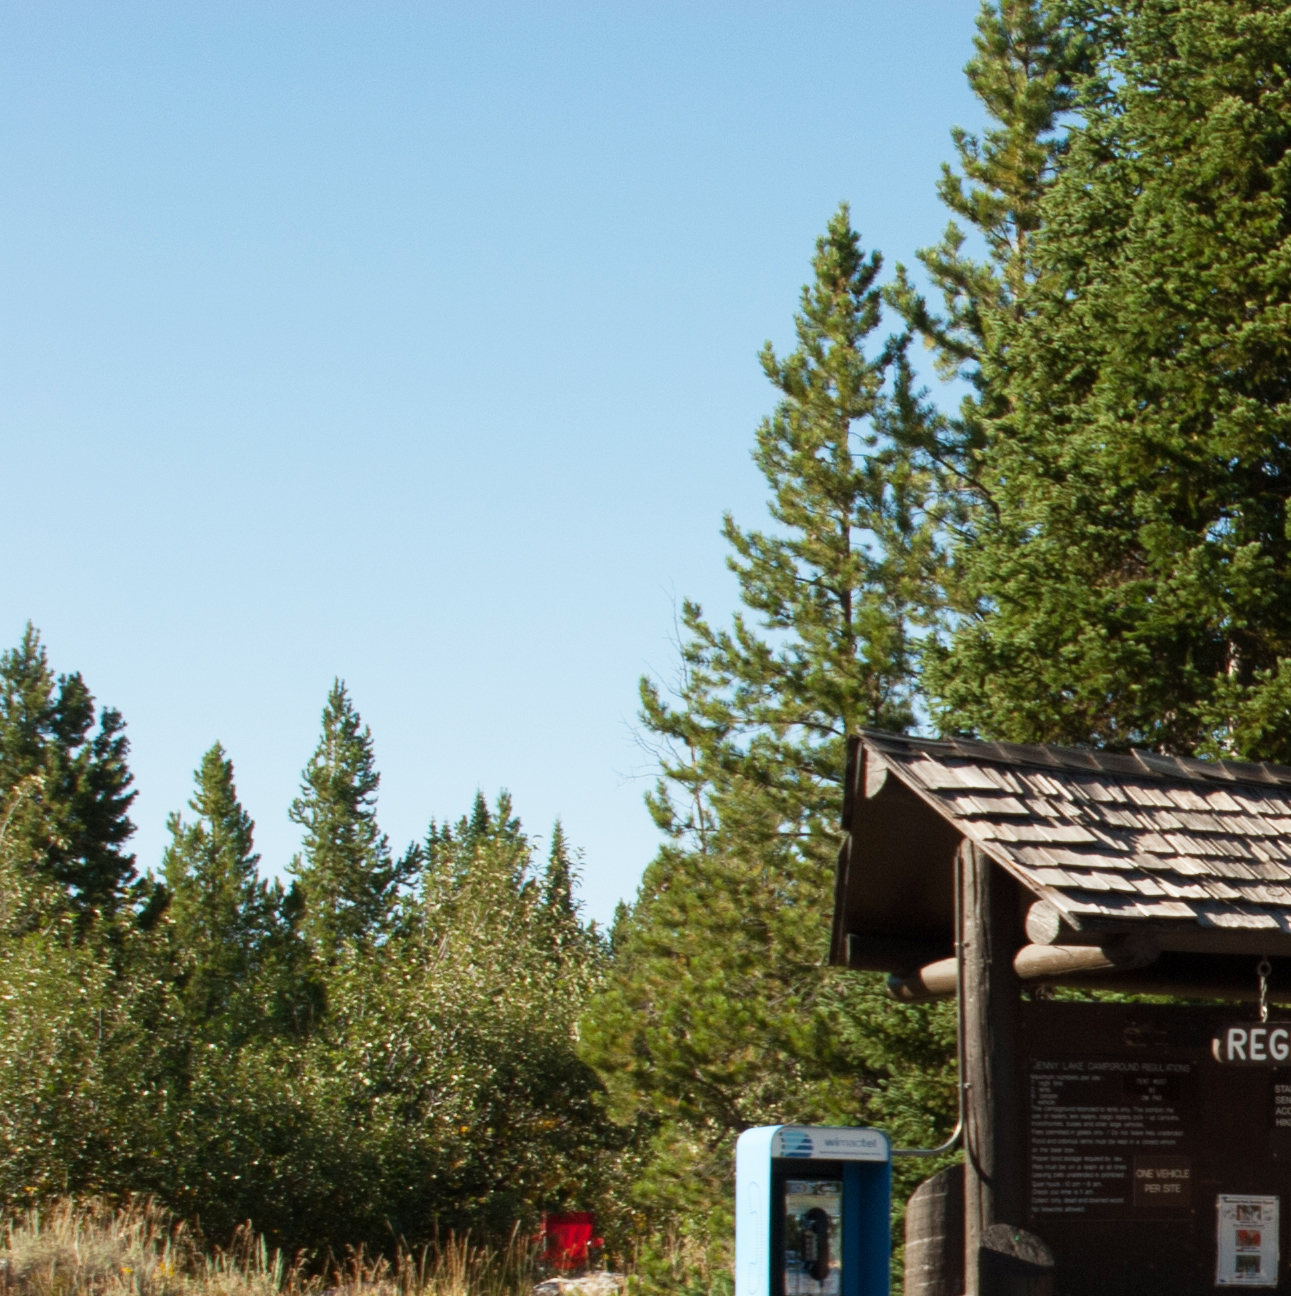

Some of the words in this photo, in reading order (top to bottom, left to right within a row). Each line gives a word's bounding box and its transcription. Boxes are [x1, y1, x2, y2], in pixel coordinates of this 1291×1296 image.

[1033, 1061, 1059, 1070] JENNY
[1063, 1062, 1084, 1071] LAKE
[1088, 1062, 1140, 1072] CAMPGROUND
[1136, 1169, 1154, 1179] ONE
[1156, 1169, 1190, 1179] VEHICLE
[1144, 1184, 1161, 1193] PER
[1163, 1184, 1182, 1193] SITE
